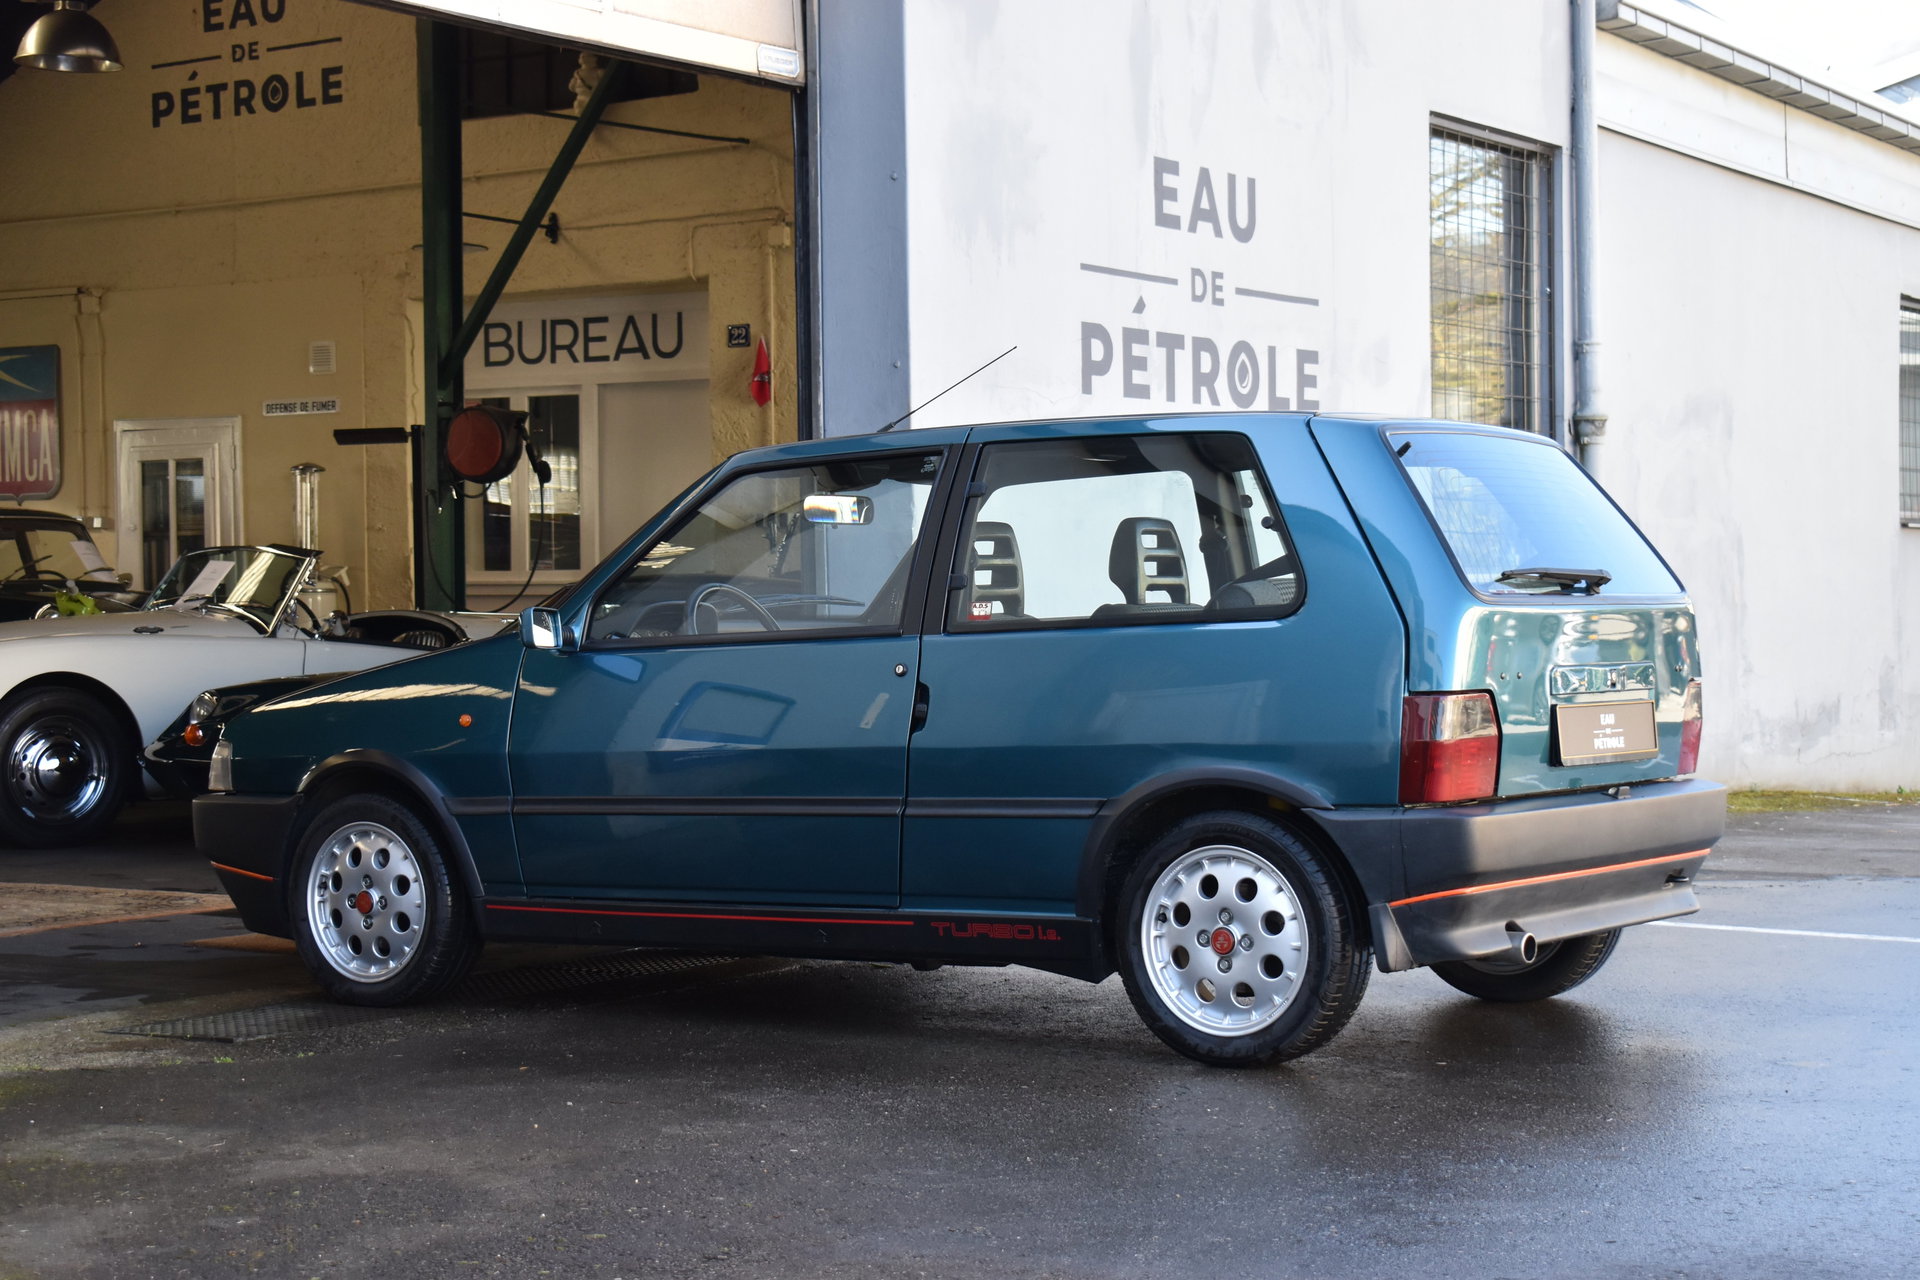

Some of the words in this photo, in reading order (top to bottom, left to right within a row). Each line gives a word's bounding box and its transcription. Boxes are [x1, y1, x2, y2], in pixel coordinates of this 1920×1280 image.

[203, 0, 286, 32] EAU
[231, 41, 260, 62] DE
[151, 65, 343, 128] PÉTROLE
[1153, 155, 1257, 244] EAU
[1190, 266, 1225, 307] DE
[484, 311, 684, 367] BUREAU
[731, 327, 747, 344] 22
[1080, 295, 1320, 411] PÉTROLE
[265, 402, 298, 414] DEFENSE
[300, 401, 309, 412] DE
[312, 400, 337, 411] FUMER
[0, 408, 53, 482] MCA
[930, 921, 1035, 940] TURBO
